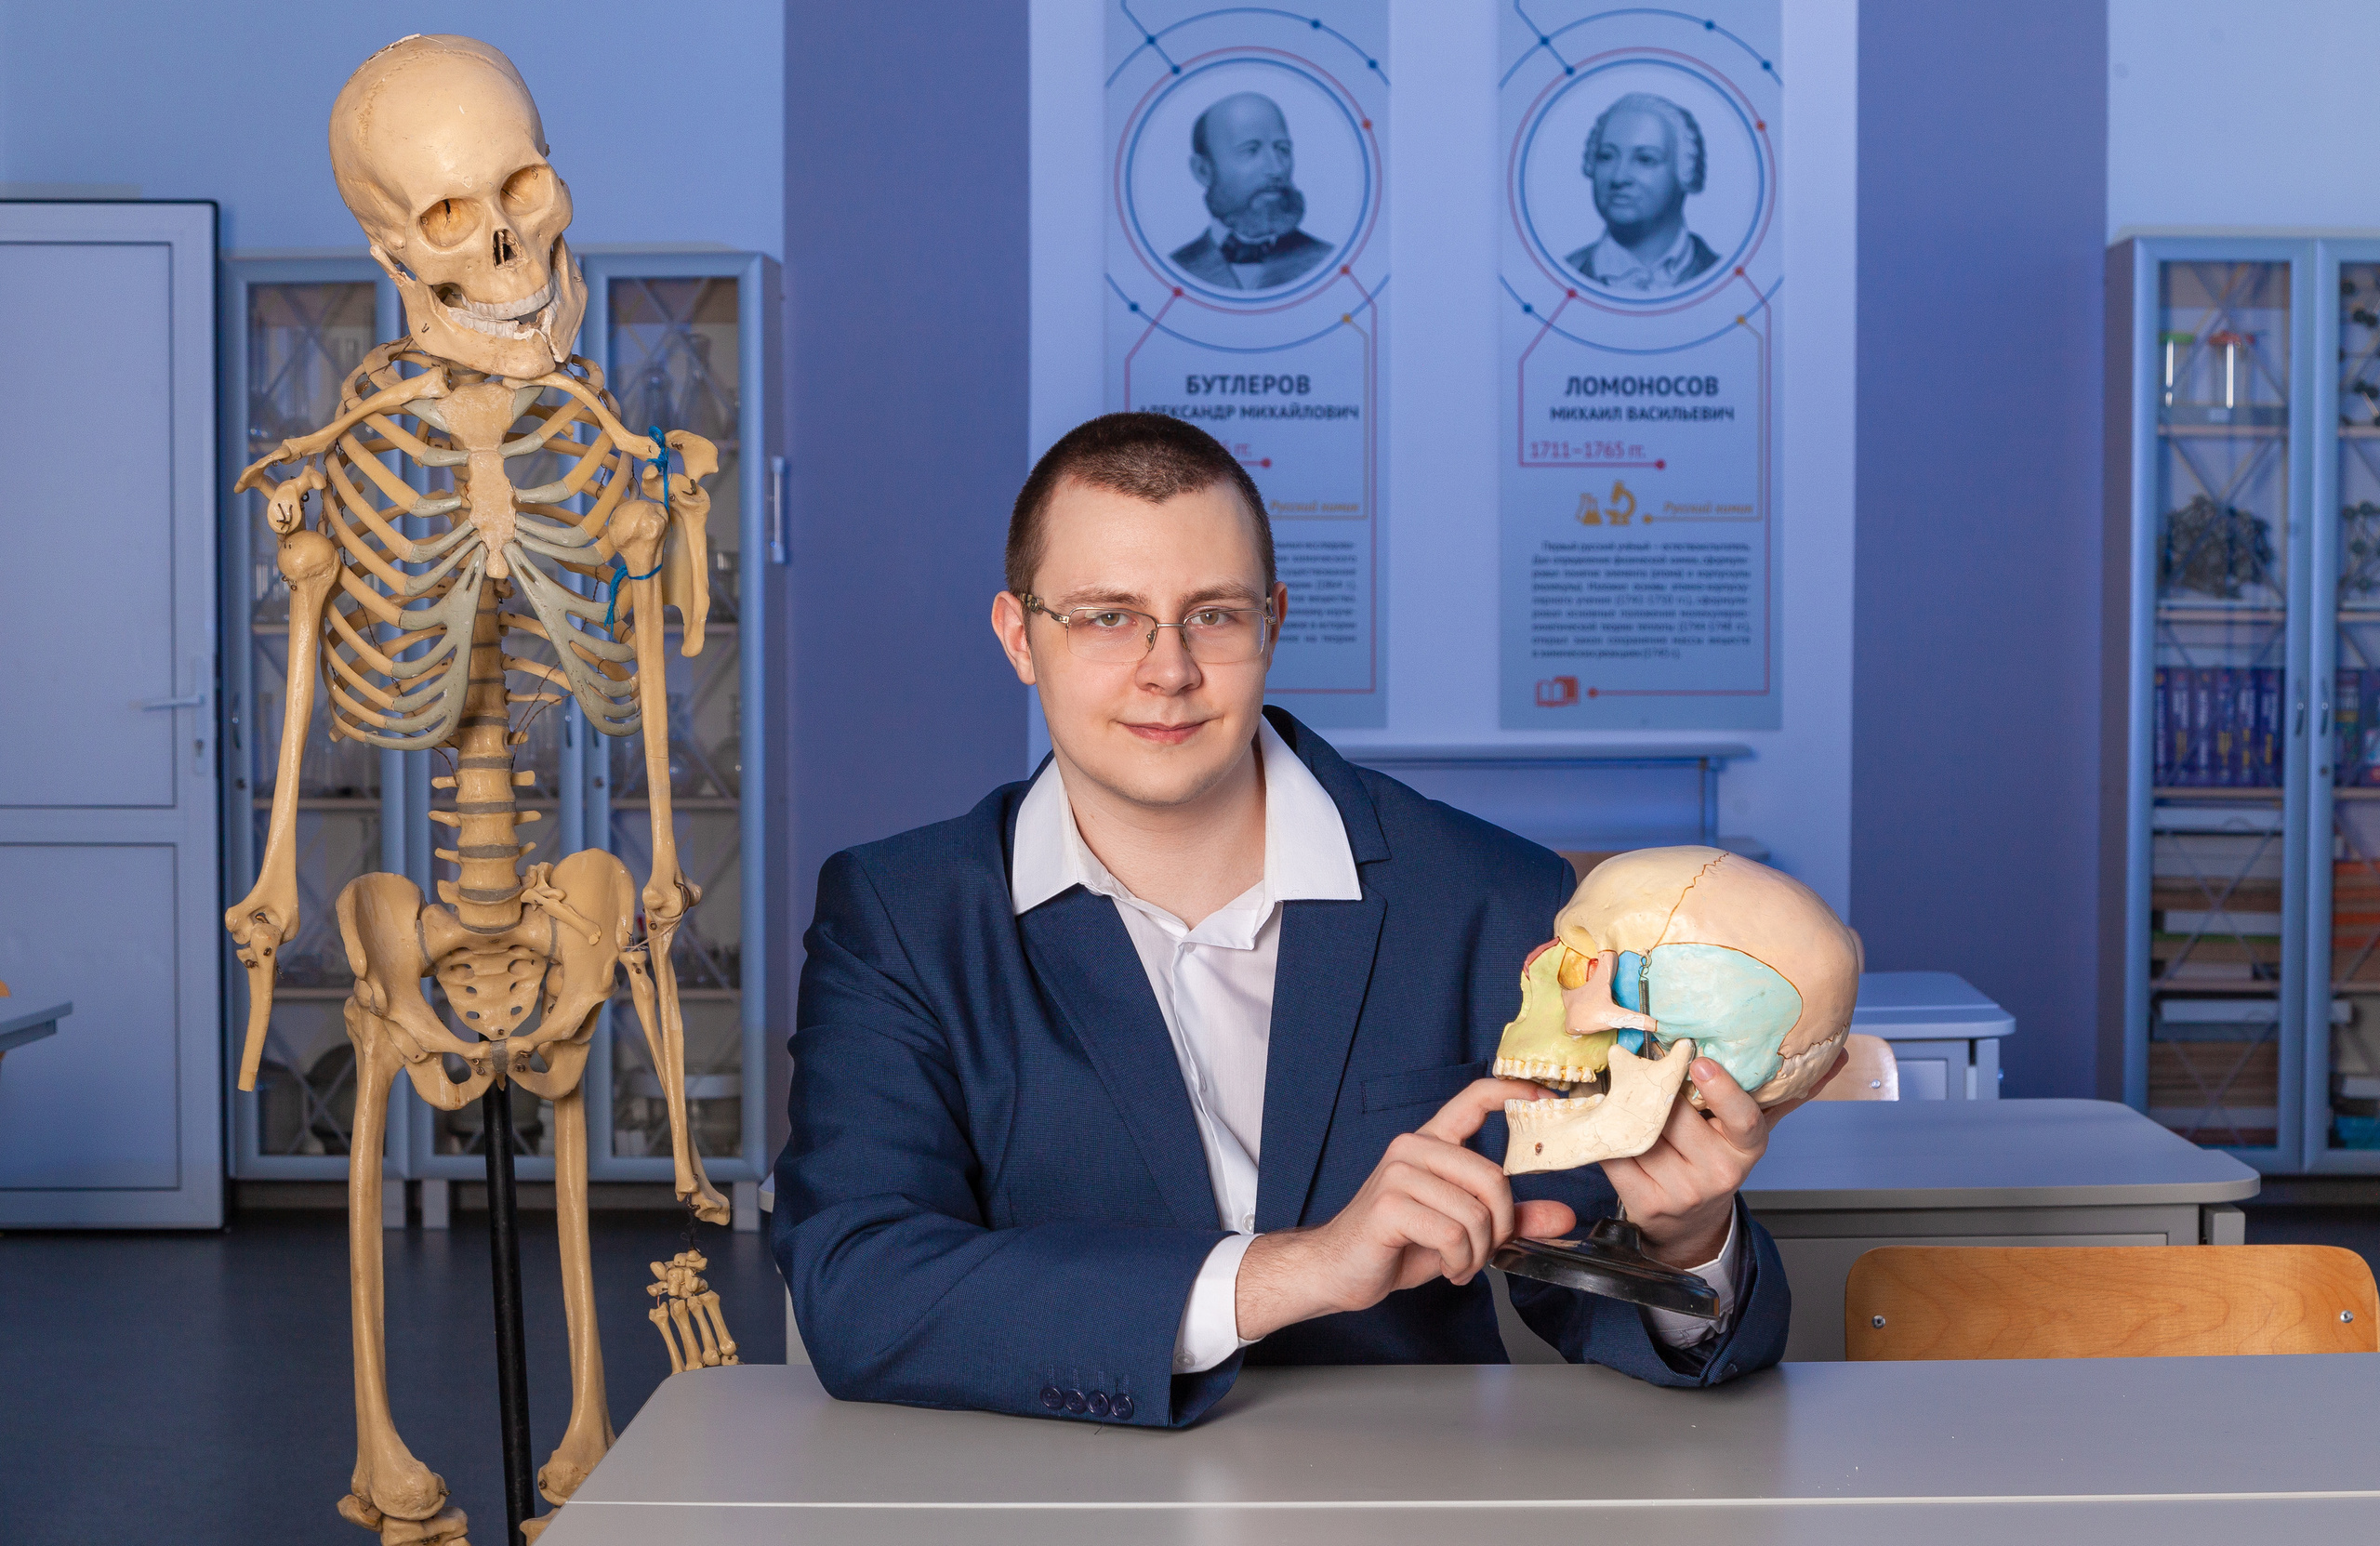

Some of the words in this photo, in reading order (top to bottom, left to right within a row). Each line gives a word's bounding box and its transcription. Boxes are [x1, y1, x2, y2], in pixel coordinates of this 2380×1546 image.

[1185, 375, 1311, 395] БУТЛЕРОВ
[1565, 376, 1720, 397] ЛОМОНОСОВ
[1240, 403, 1360, 420] МИХАЙЛОВИЧ
[1550, 407, 1622, 422] МИХАИЛ
[1627, 407, 1735, 422] ВАСИЛЬЕВИЧ
